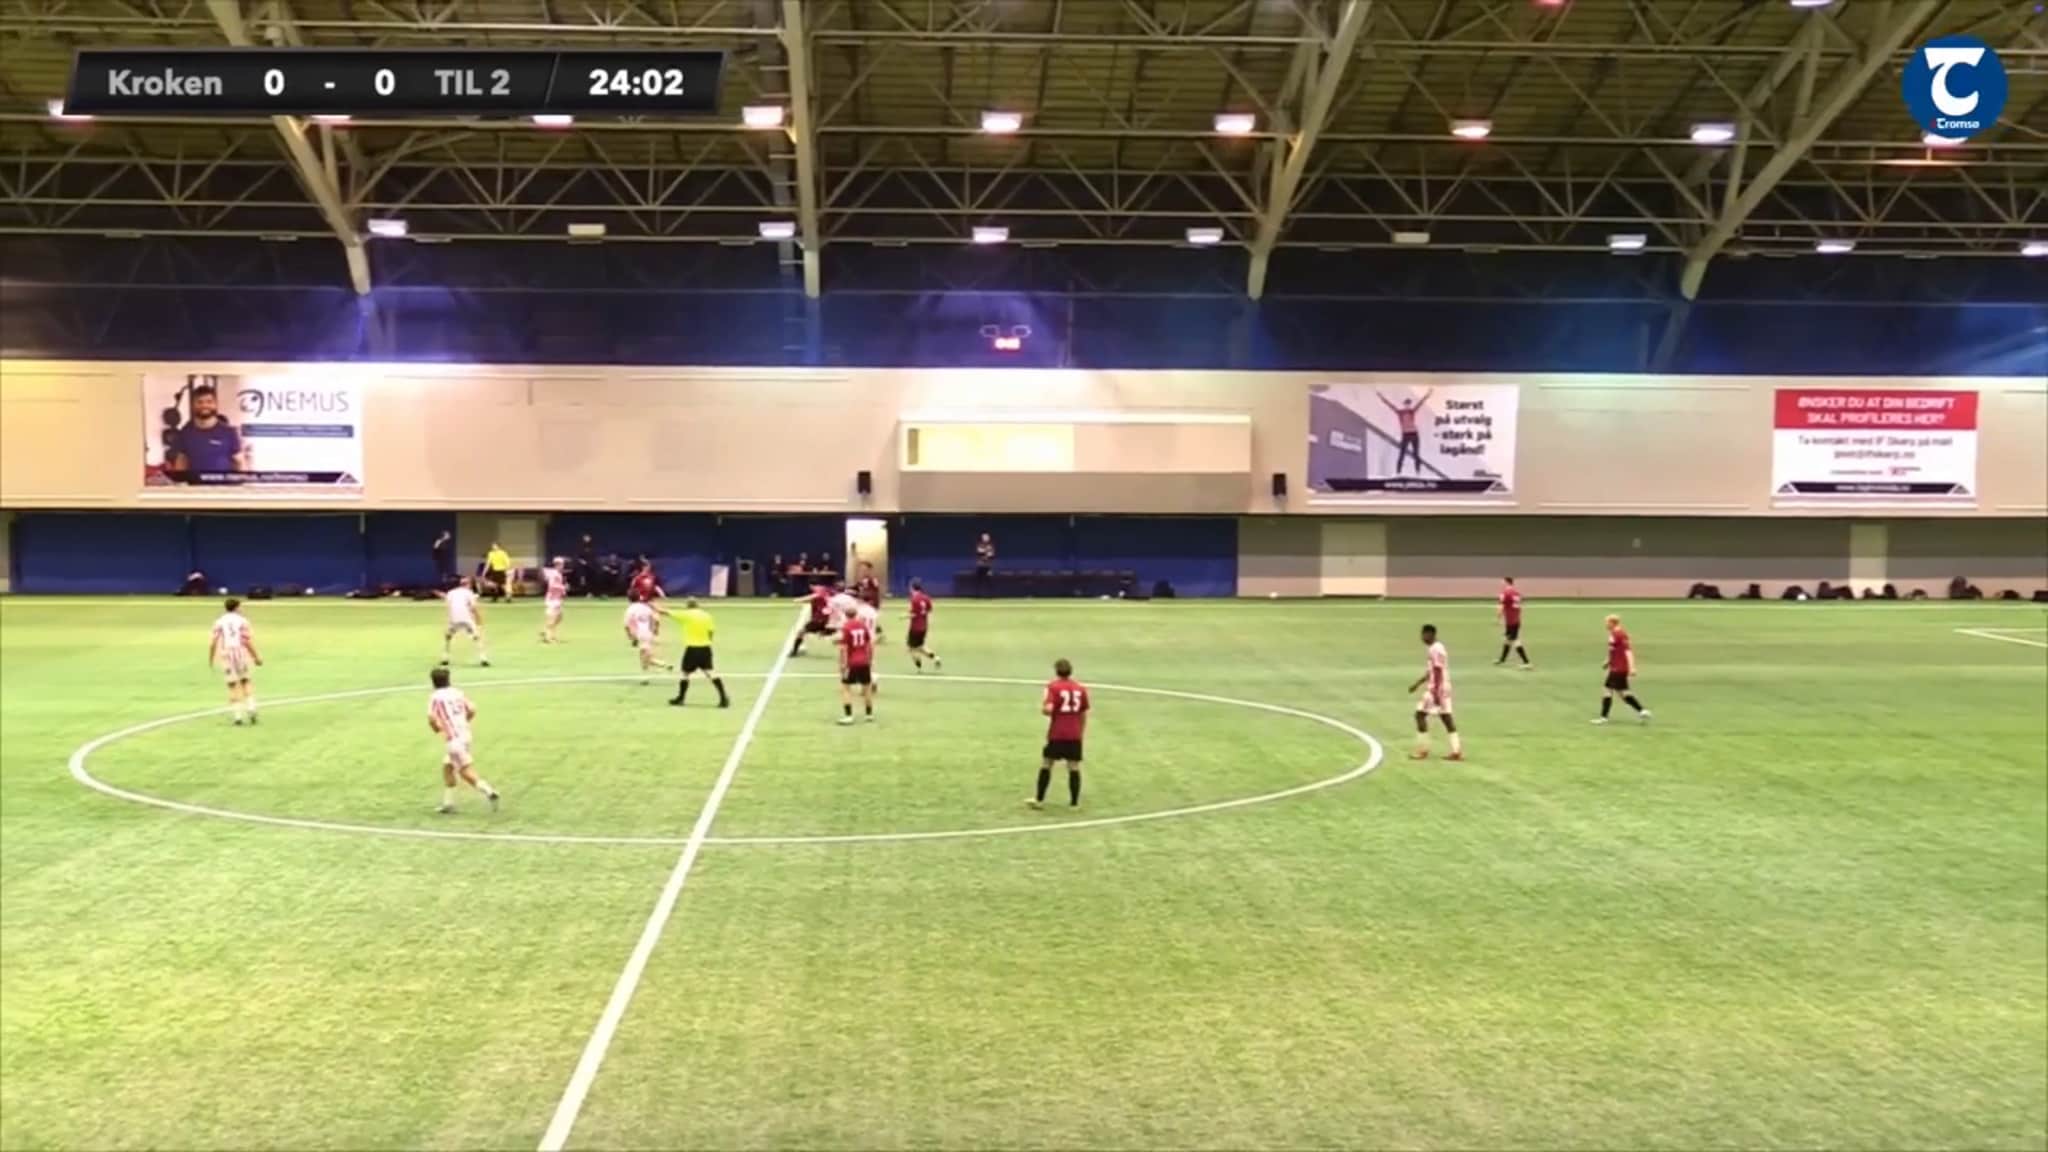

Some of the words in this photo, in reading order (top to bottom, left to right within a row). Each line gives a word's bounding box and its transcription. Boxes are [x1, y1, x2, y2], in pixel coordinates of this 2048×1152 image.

[266, 390, 350, 413] NEMUS
[1434, 413, 1451, 427] på
[1453, 413, 1492, 427] utvalg
[1059, 689, 1083, 713] 25
